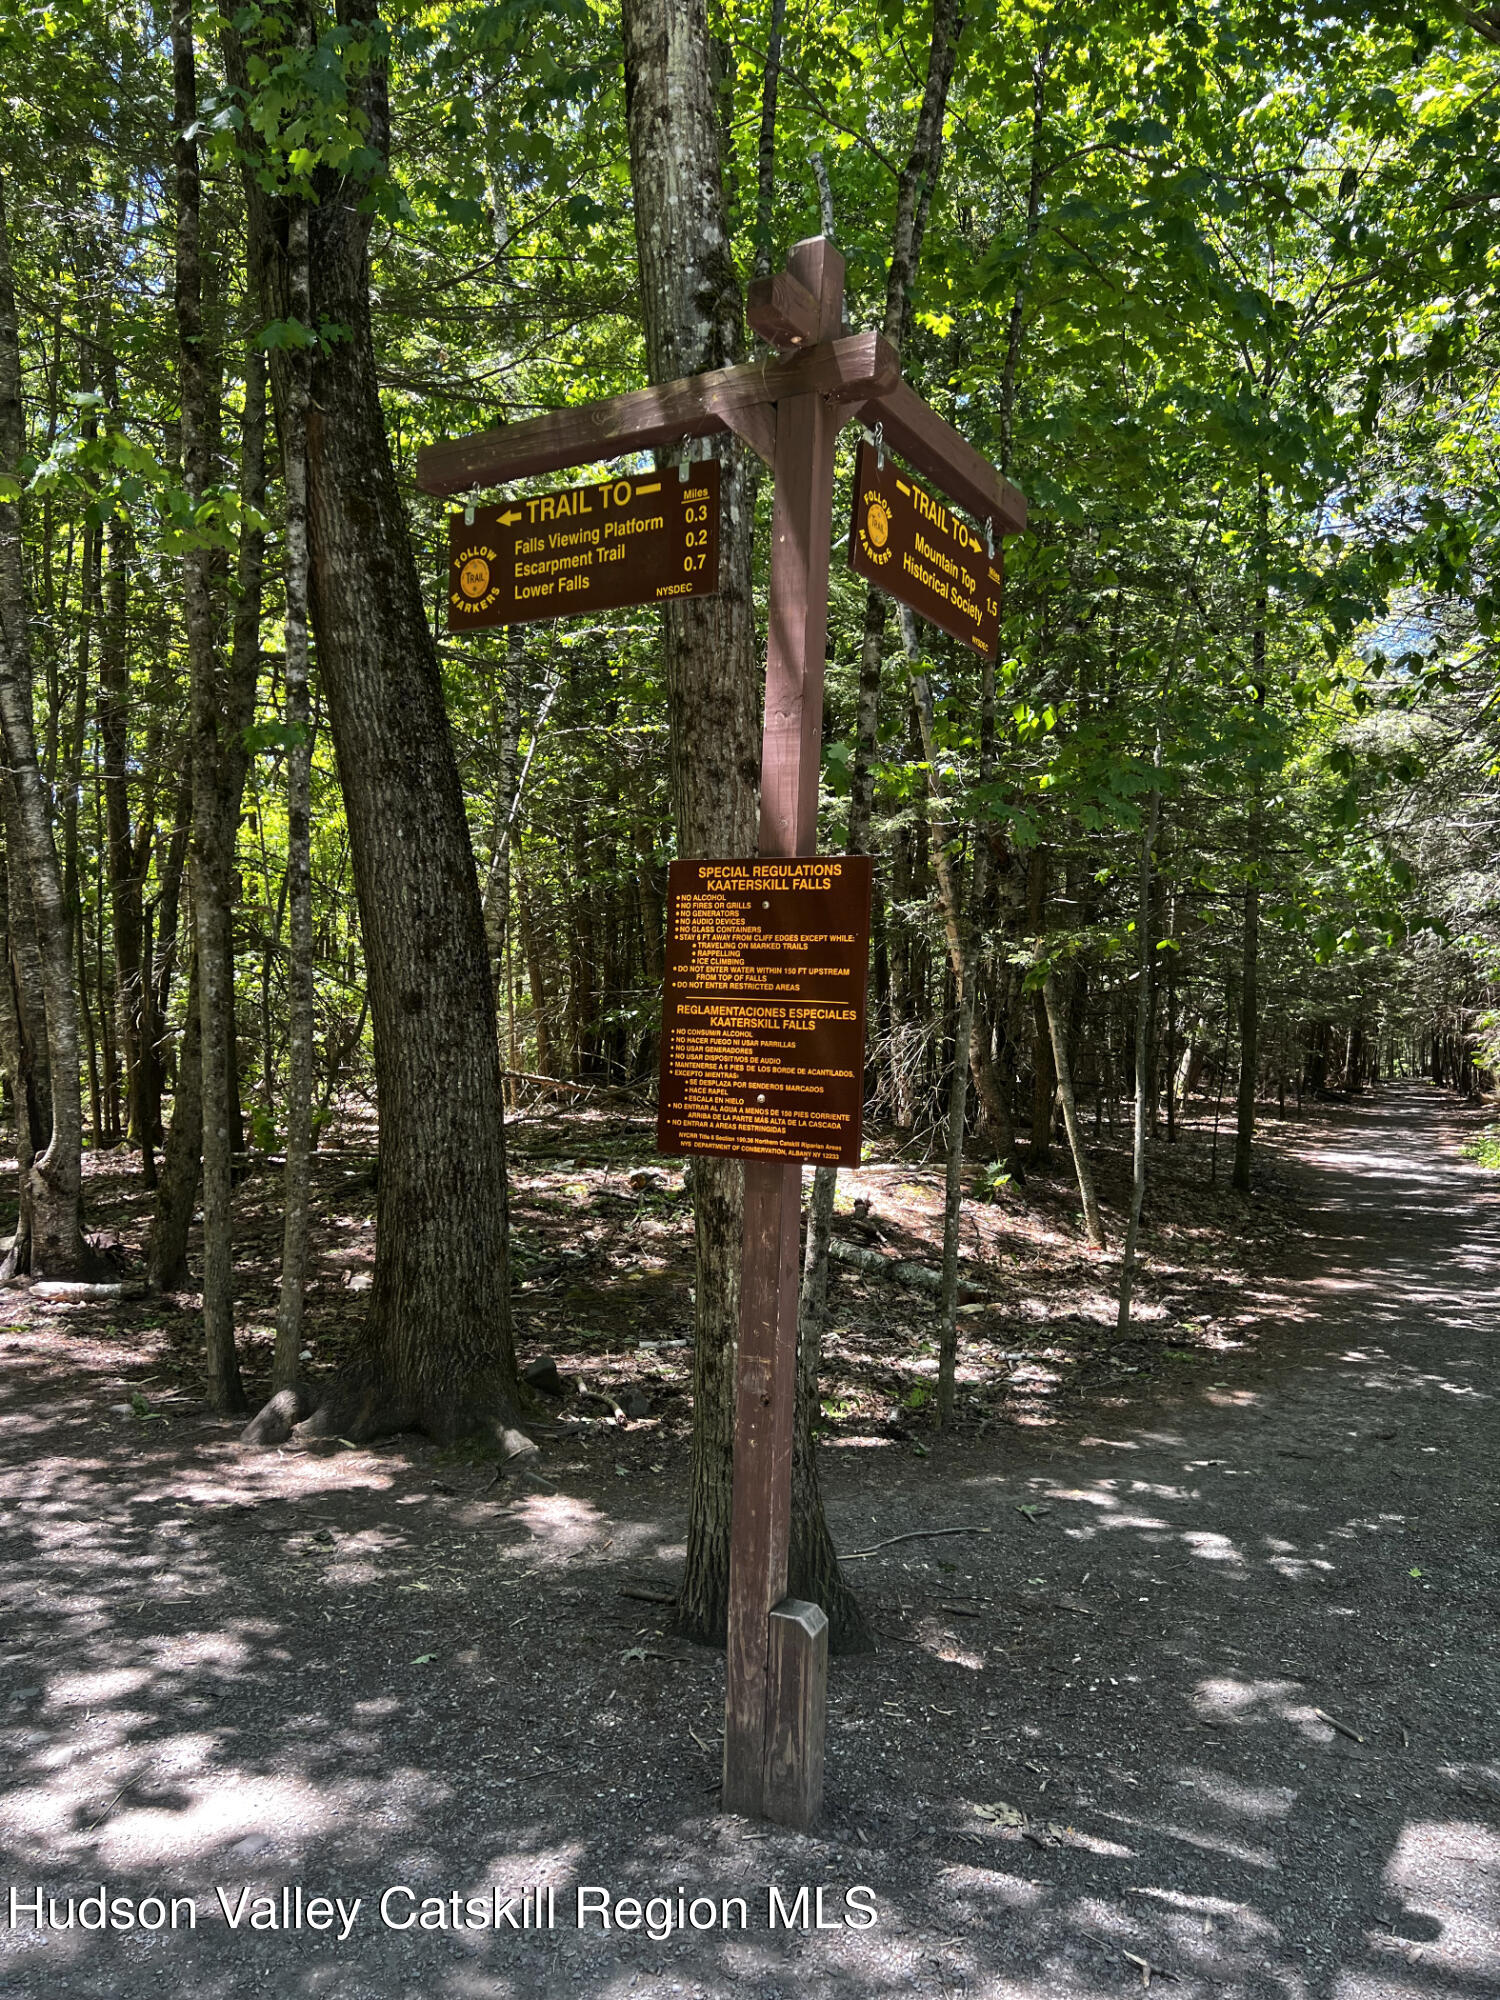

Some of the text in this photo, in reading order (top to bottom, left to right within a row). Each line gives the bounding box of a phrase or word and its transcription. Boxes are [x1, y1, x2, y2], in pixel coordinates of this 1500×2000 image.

[683, 488, 709, 500] Miles
[526, 481, 632, 524] TRAIL TO
[864, 490, 893, 519] FOLLOW
[685, 505, 708, 524] 0.3
[912, 484, 969, 548] TRAIL TO
[514, 515, 664, 556] Falls Viewing Platform
[685, 529, 708, 548] 0.2
[858, 528, 892, 566] MARKERS
[454, 545, 497, 569] FOLLOW
[514, 544, 626, 578] Escarpment Trail
[683, 554, 706, 572] 0.7
[914, 532, 976, 593] Mountain Top
[514, 575, 590, 600] Lower Falls
[656, 582, 693, 597] NYSDEC
[903, 552, 983, 627] Historical Society
[450, 586, 500, 613] MARKERS
[986, 597, 997, 617] 1.5
[972, 635, 989, 652] NYSDEC
[698, 864, 842, 878] SPECIAL REGULATIONS
[707, 878, 831, 891] KAATERSKILL FALLS
[750, 942, 781, 950] MARKED
[782, 942, 808, 950] TRAILS
[745, 974, 767, 982] FALLS
[756, 966, 782, 974] WITHIN
[808, 968, 850, 976] UPSTREAM
[729, 982, 774, 991] RESTRICTED
[676, 1004, 856, 1020] REGLAMENTACIONES ESPECIALES
[710, 1017, 816, 1031] KAATERSKILL FALLS
[722, 1030, 753, 1038] ALCOHOL
[705, 1046, 753, 1055] GENERADORES
[760, 1040, 796, 1048] PARRILLAS
[704, 1054, 748, 1063] DISPOSITIVOS
[760, 1057, 781, 1065] AUDIO
[675, 1061, 718, 1070] MANTENERSE
[772, 1066, 796, 1074] BORDE
[699, 1079, 732, 1087] DESPLAZA
[748, 1082, 784, 1091] SENDEROS
[786, 1084, 824, 1094] MARCADOS
[708, 1088, 728, 1096] RAPEL
[714, 1096, 724, 1104] EN
[725, 1097, 745, 1105] HIELO
[688, 1112, 711, 1120] ARRIBA
[732, 1115, 753, 1123] PARTE
[808, 1121, 842, 1130] CASCADA
[745, 1107, 769, 1116] MENOS
[793, 1111, 809, 1119] PIES
[810, 1112, 851, 1122] CORRIENTE
[683, 1120, 708, 1128] ENTRAR
[738, 1124, 786, 1134] RESTRINGIDAS
[694, 1141, 731, 1150] DEPARTMENT
